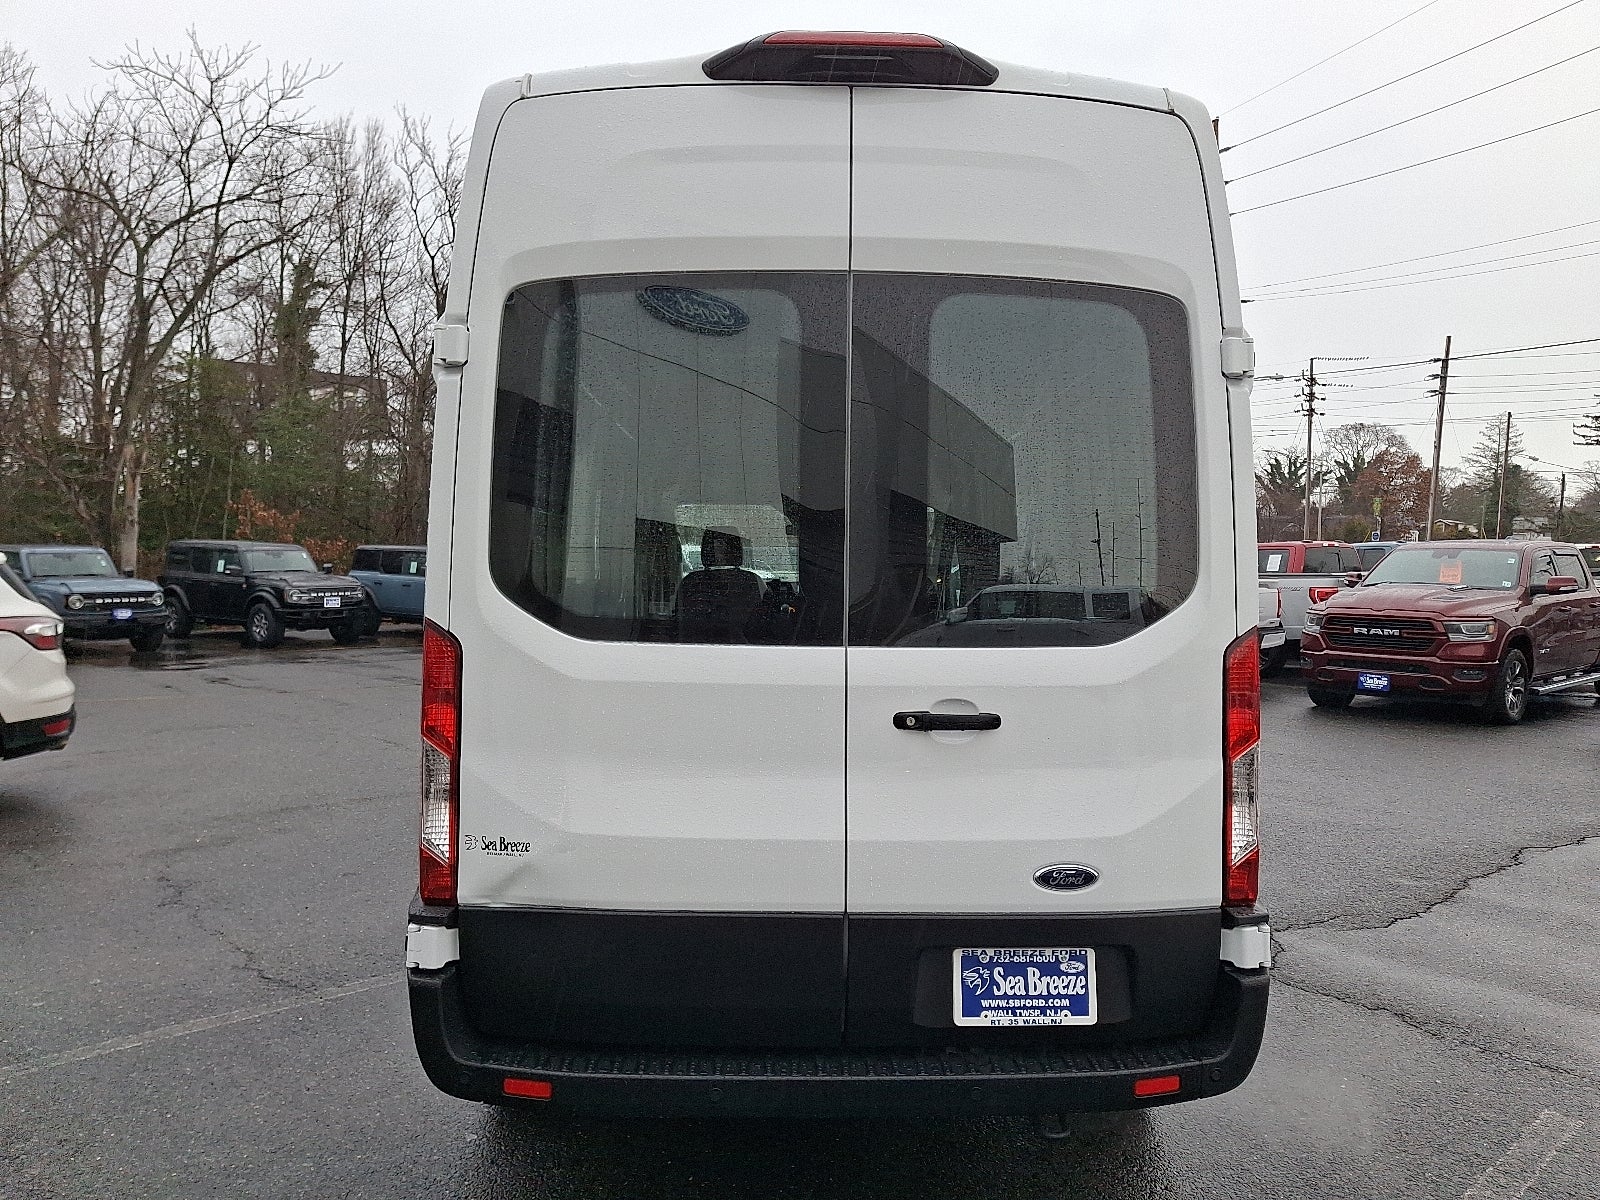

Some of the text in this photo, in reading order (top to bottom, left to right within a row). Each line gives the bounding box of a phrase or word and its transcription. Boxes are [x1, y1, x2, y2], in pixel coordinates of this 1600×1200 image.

[1353, 627, 1400, 636] RAM
[480, 835, 531, 853] Sea Breeze
[1049, 870, 1085, 885] Ford
[961, 949, 989, 957] SEA
[993, 949, 1047, 957] BREEZE
[993, 966, 1086, 996] Sea Breeze
[981, 999, 1070, 1008] WWW.SBFORD.COM
[989, 1009, 1014, 1017] WALL
